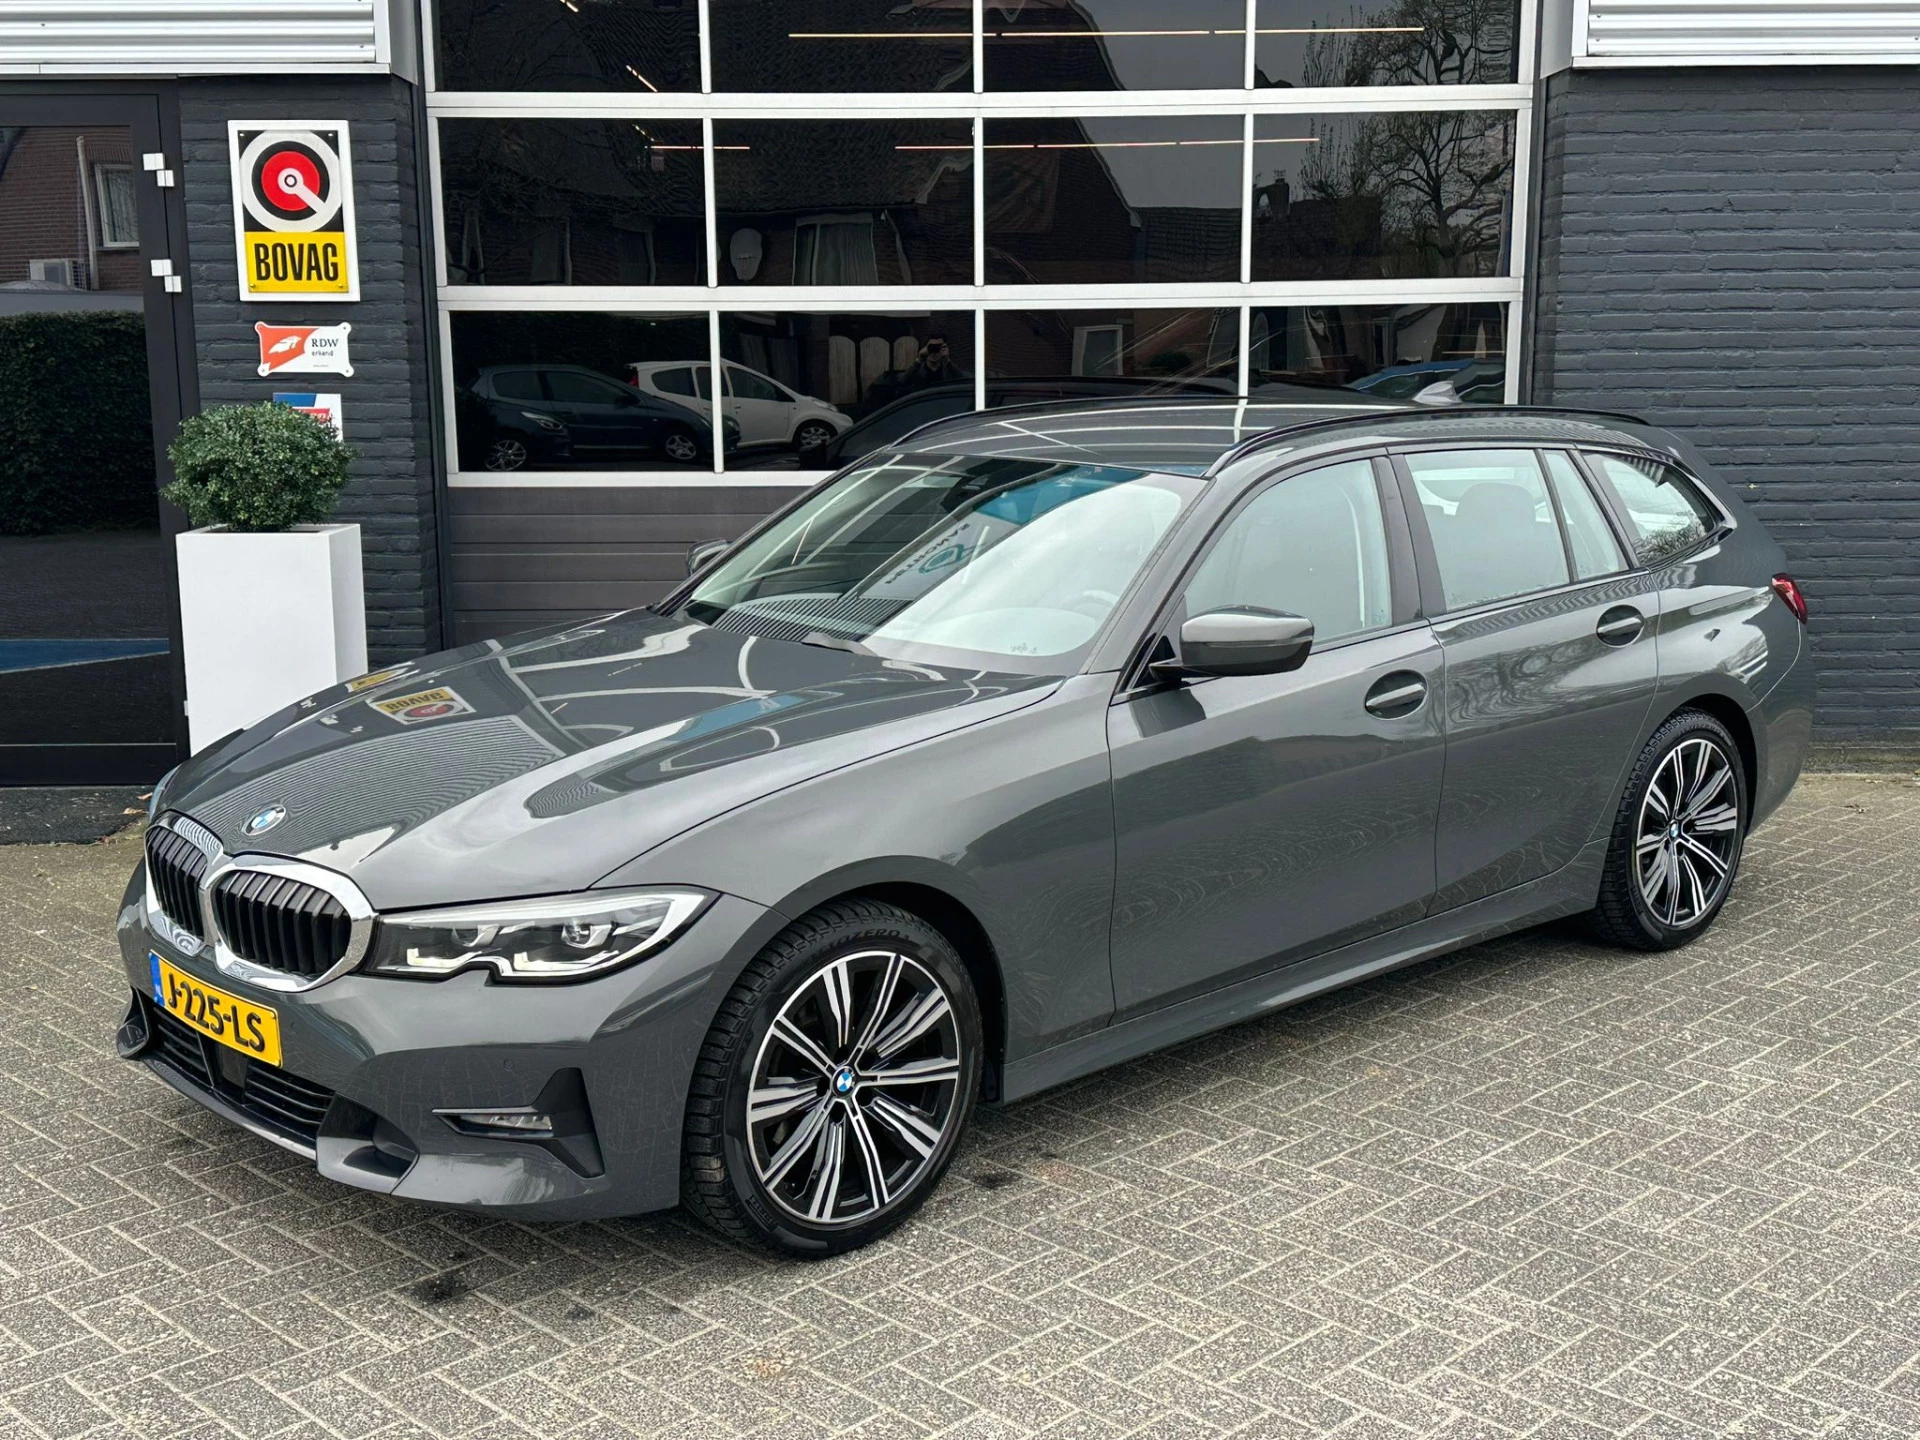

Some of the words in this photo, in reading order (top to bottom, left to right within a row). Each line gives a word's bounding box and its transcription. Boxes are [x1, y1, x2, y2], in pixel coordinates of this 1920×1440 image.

[254, 242, 339, 281] BOVAG
[311, 338, 339, 348] RDW
[168, 973, 265, 1053] J-225-LS
